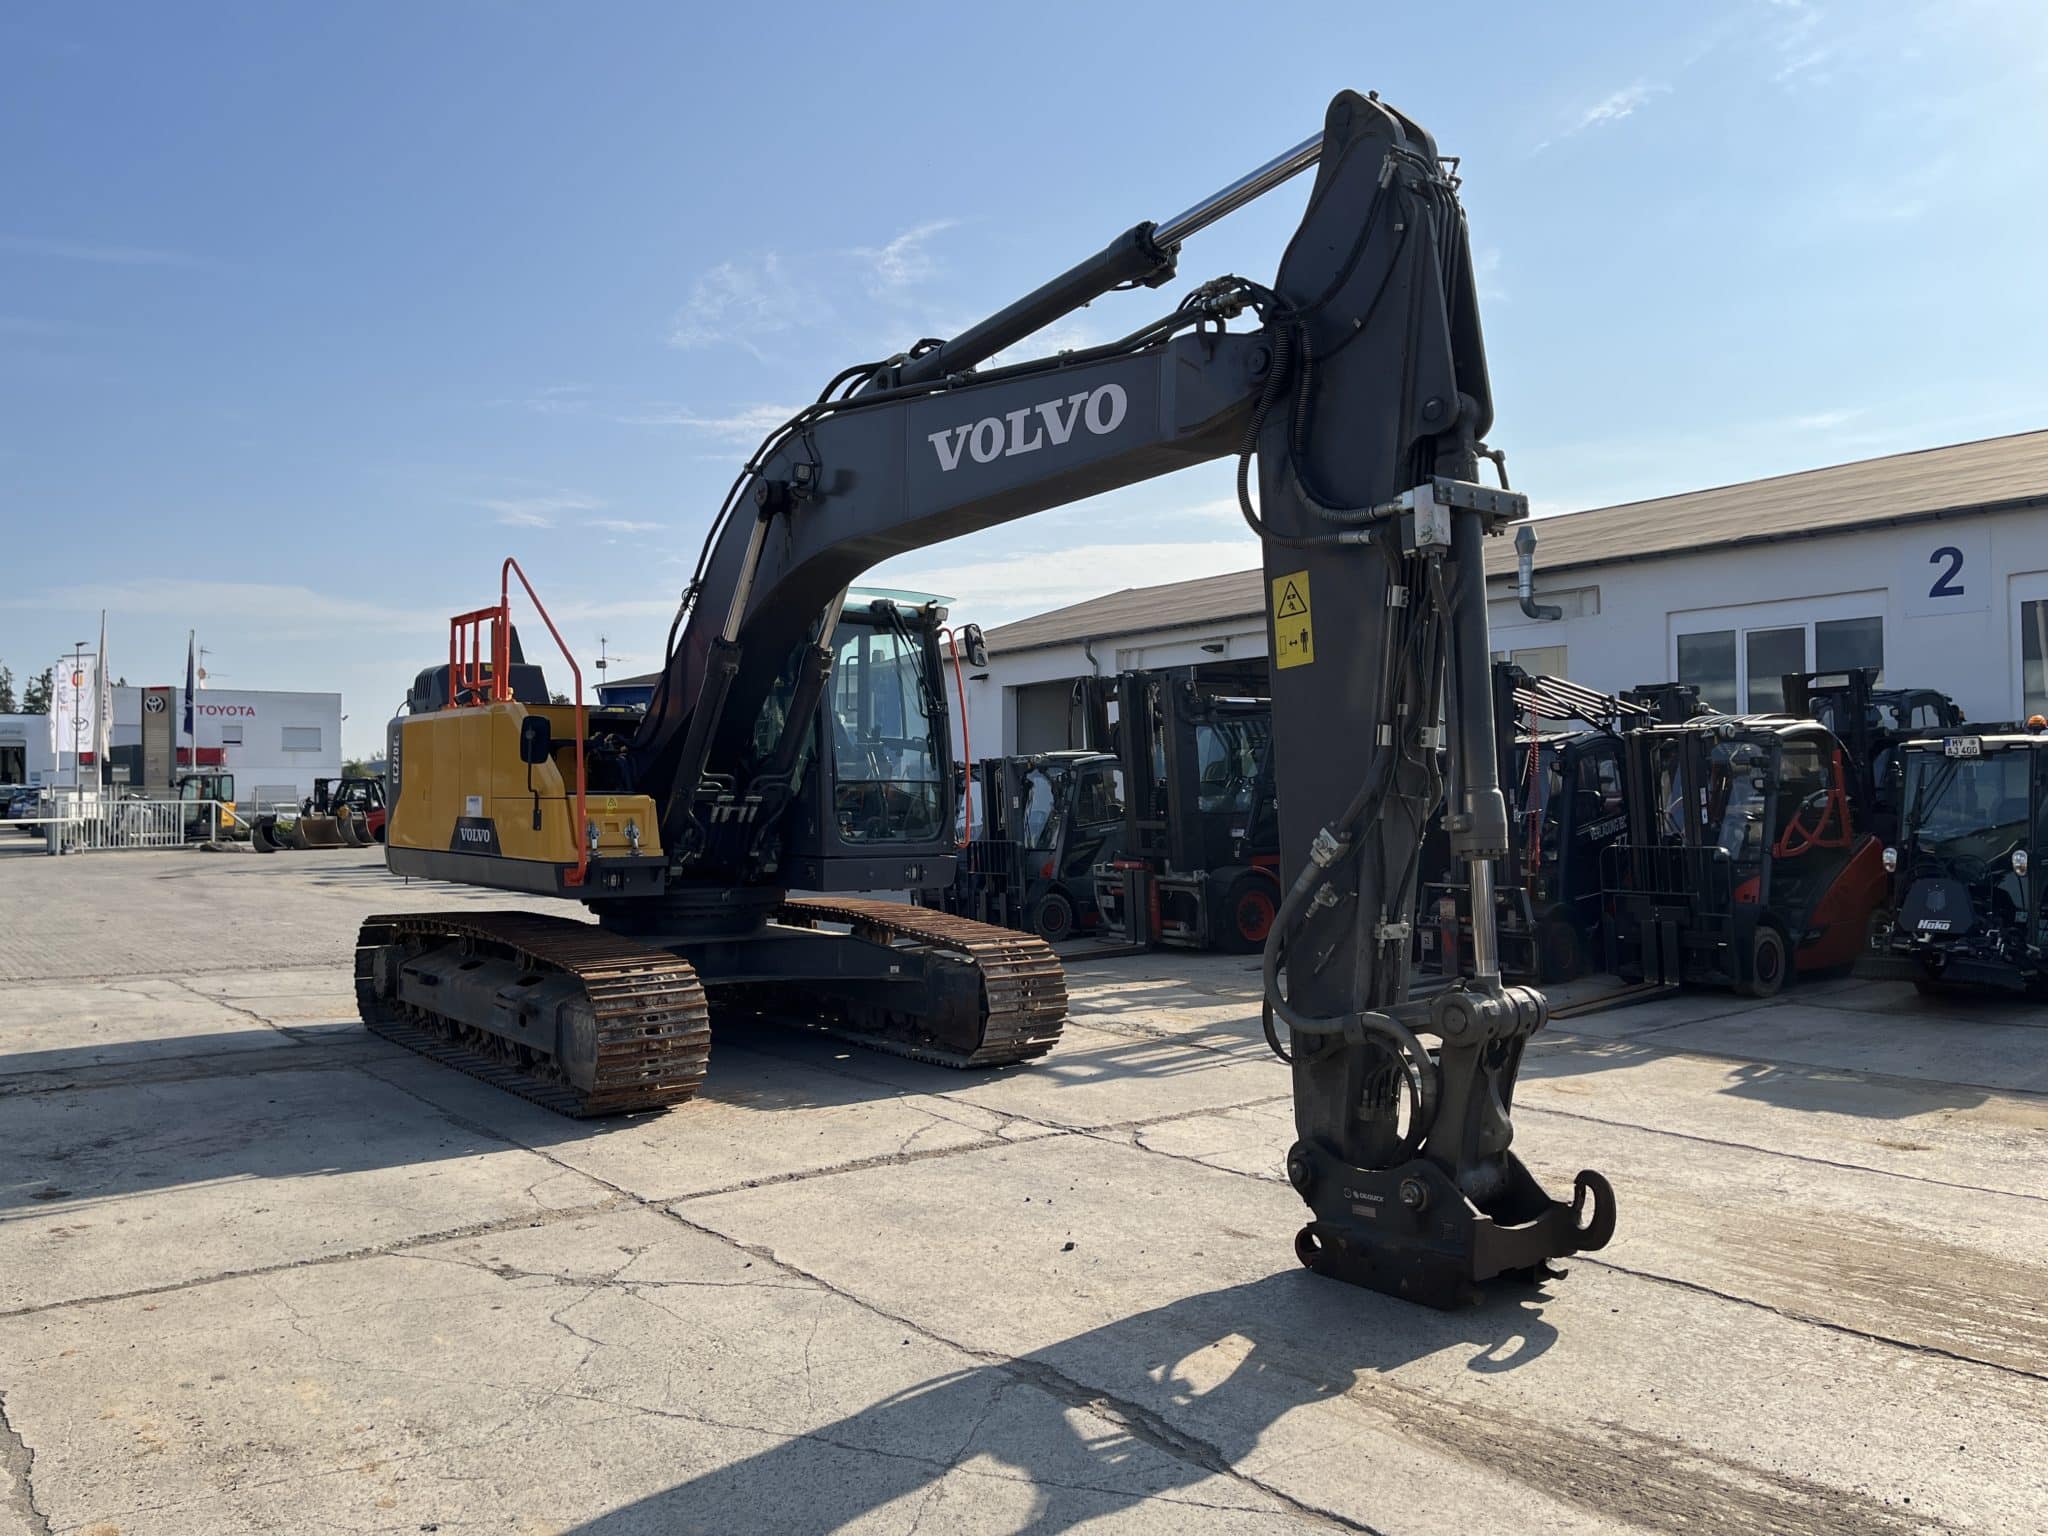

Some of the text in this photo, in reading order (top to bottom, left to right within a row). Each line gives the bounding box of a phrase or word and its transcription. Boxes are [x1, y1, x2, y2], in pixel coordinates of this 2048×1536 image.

[928, 384, 1128, 471] VOLVO
[1929, 546, 1964, 598] 2
[197, 705, 255, 716] TOYOTA
[460, 827, 490, 843] VOLVO
[1917, 919, 1951, 930] Hako
